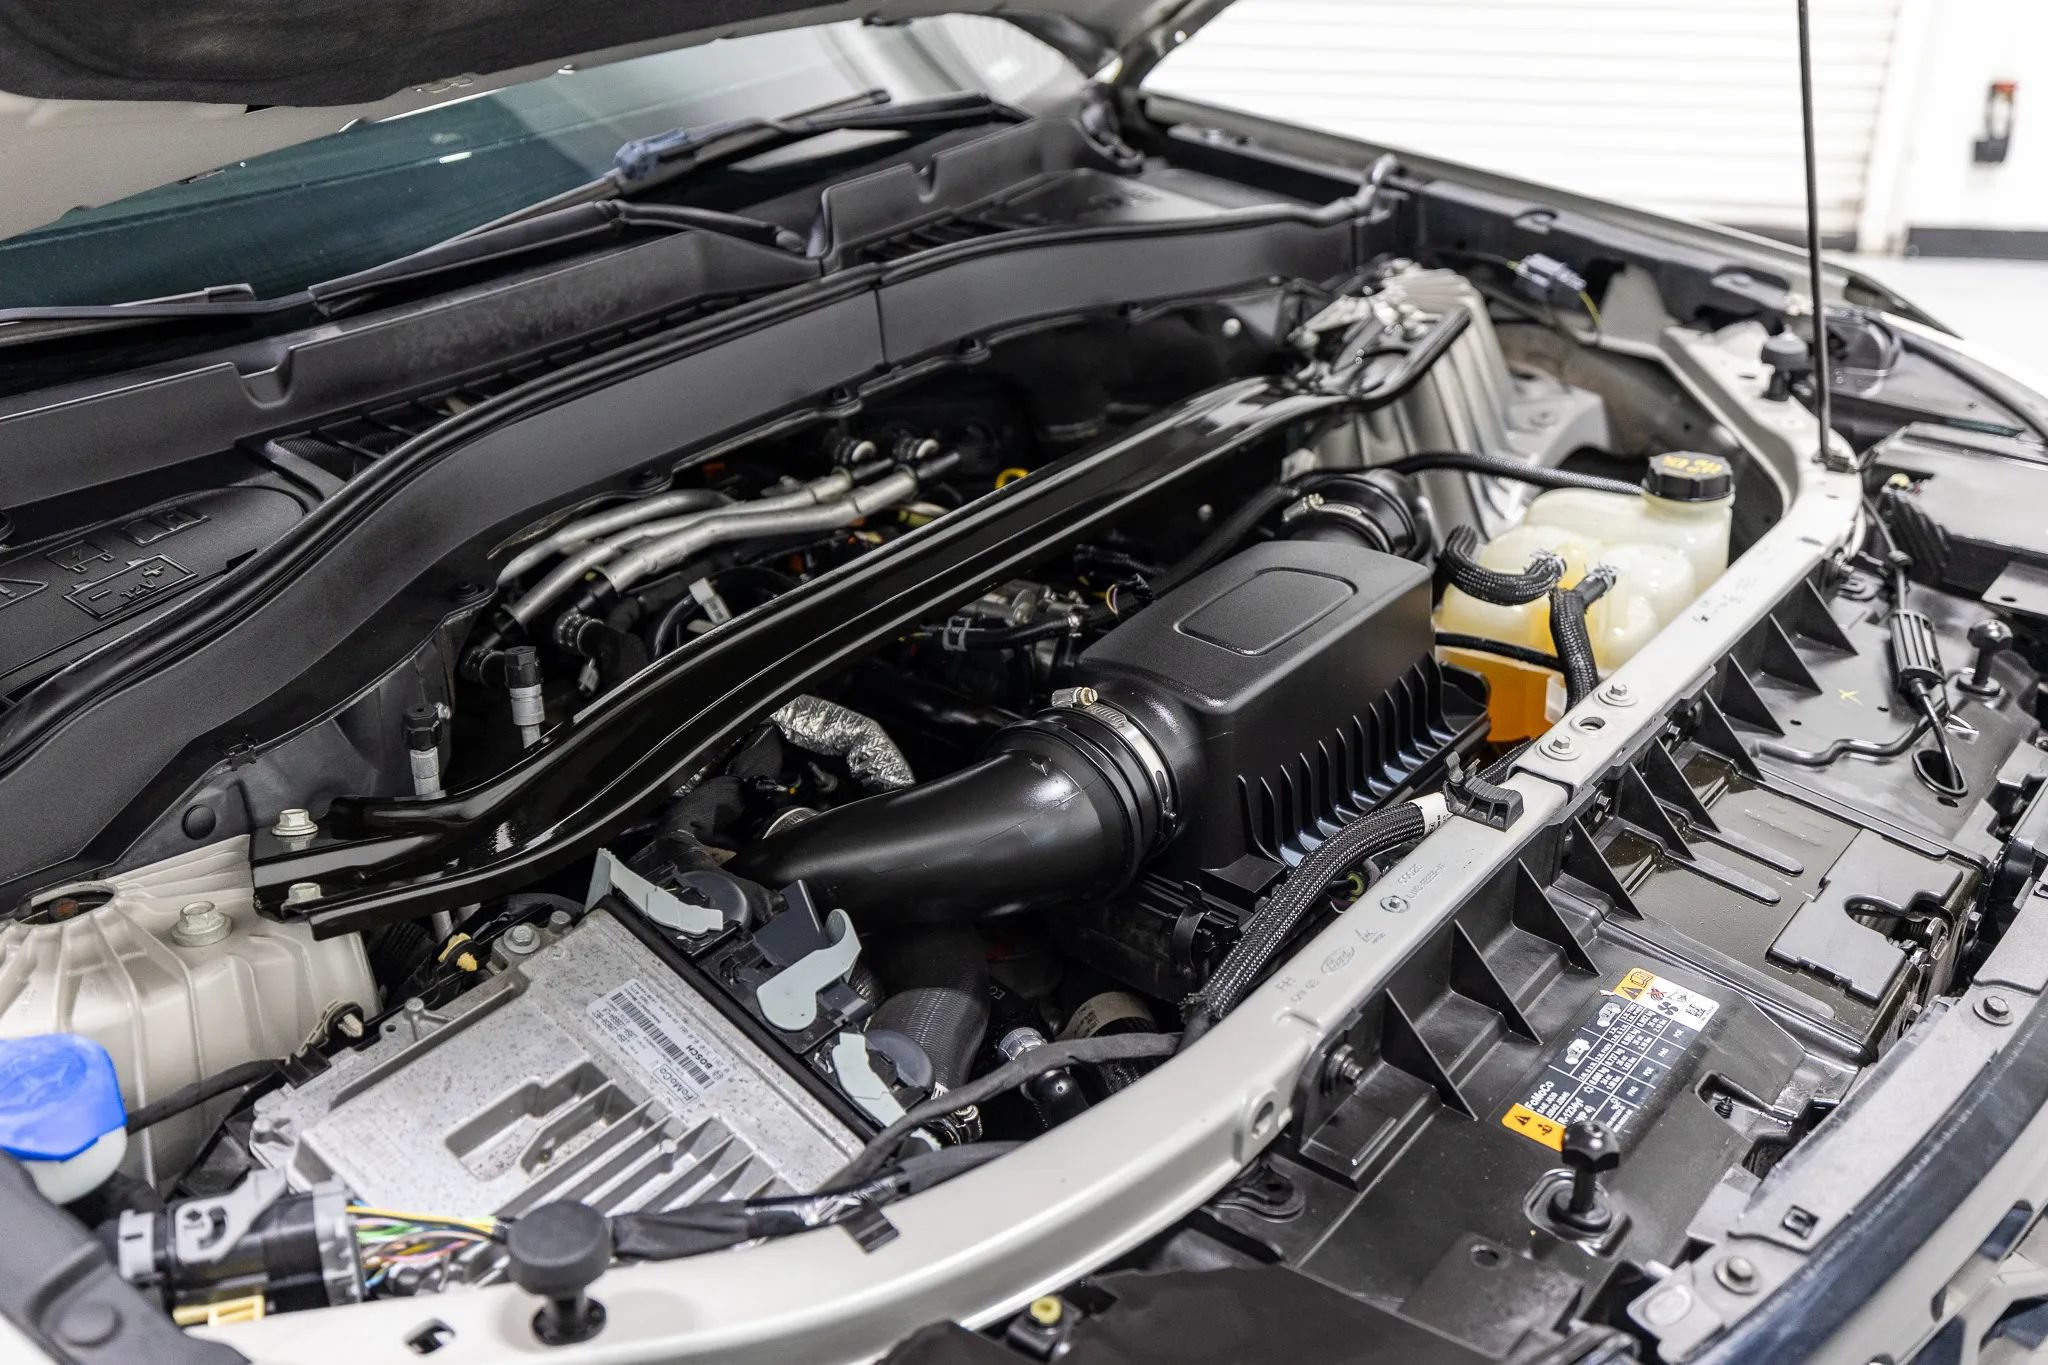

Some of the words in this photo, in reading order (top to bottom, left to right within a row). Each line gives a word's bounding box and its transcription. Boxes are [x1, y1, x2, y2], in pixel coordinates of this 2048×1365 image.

[120, 580, 156, 600] 12V
[683, 1043, 714, 1070] BOSCH
[1656, 1046, 1670, 1058] PAG
[656, 1066, 695, 1102] FoMoCo
[1523, 1079, 1555, 1110] FoMoCo
[1625, 1084, 1639, 1097] PAG
[1555, 1096, 1586, 1126] R-1234yf
